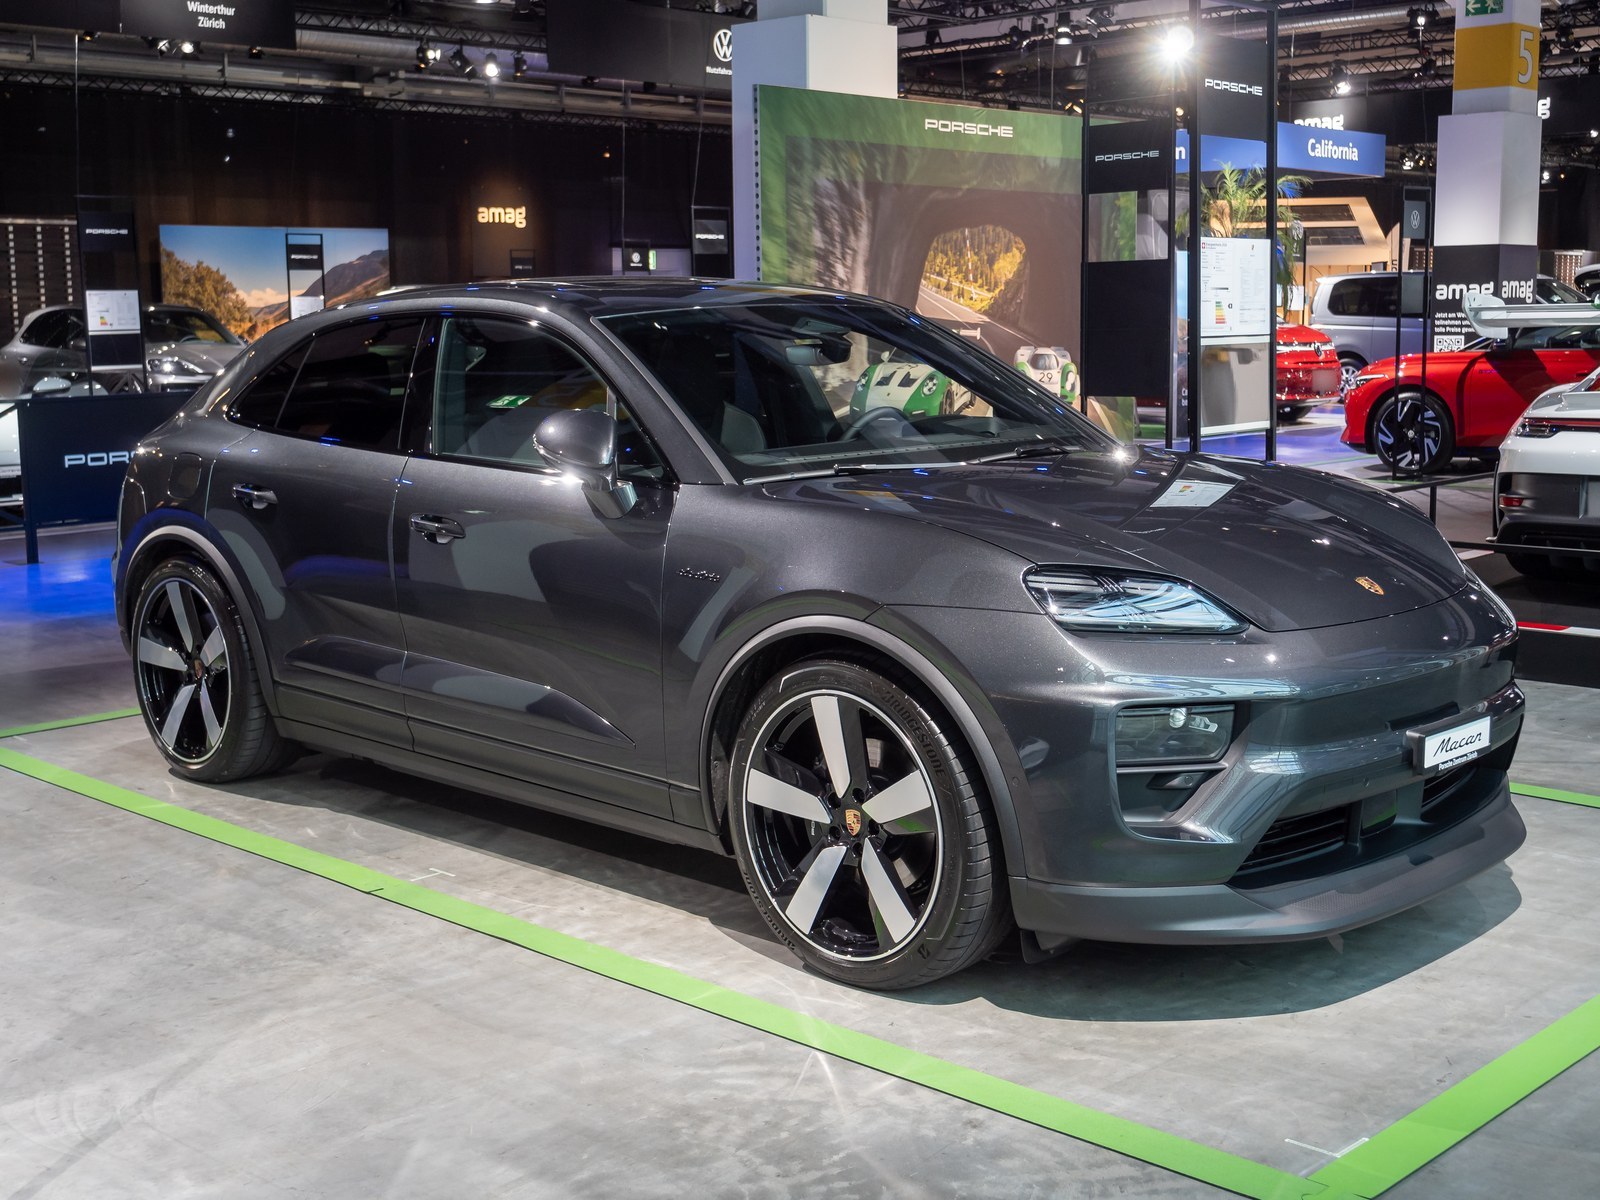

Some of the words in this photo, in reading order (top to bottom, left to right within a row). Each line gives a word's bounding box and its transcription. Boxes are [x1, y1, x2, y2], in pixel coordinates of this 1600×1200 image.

[187, 1, 236, 16] Winterthur
[197, 16, 225, 29] Zürich
[1517, 29, 1535, 85] 5
[1204, 78, 1263, 97] PORSCHE
[924, 118, 1013, 138] PORSCHE
[1095, 150, 1160, 163] PORSCHE
[1307, 138, 1359, 161] California
[477, 206, 527, 229] amag
[1501, 278, 1534, 304] amag
[1039, 372, 1053, 383] 29
[881, 691, 946, 777] BRIDGESTONE
[1433, 732, 1482, 757] Macan
[1438, 760, 1453, 770] Porsche
[1453, 757, 1467, 766] Zentrum
[1467, 751, 1478, 760] Zürich
